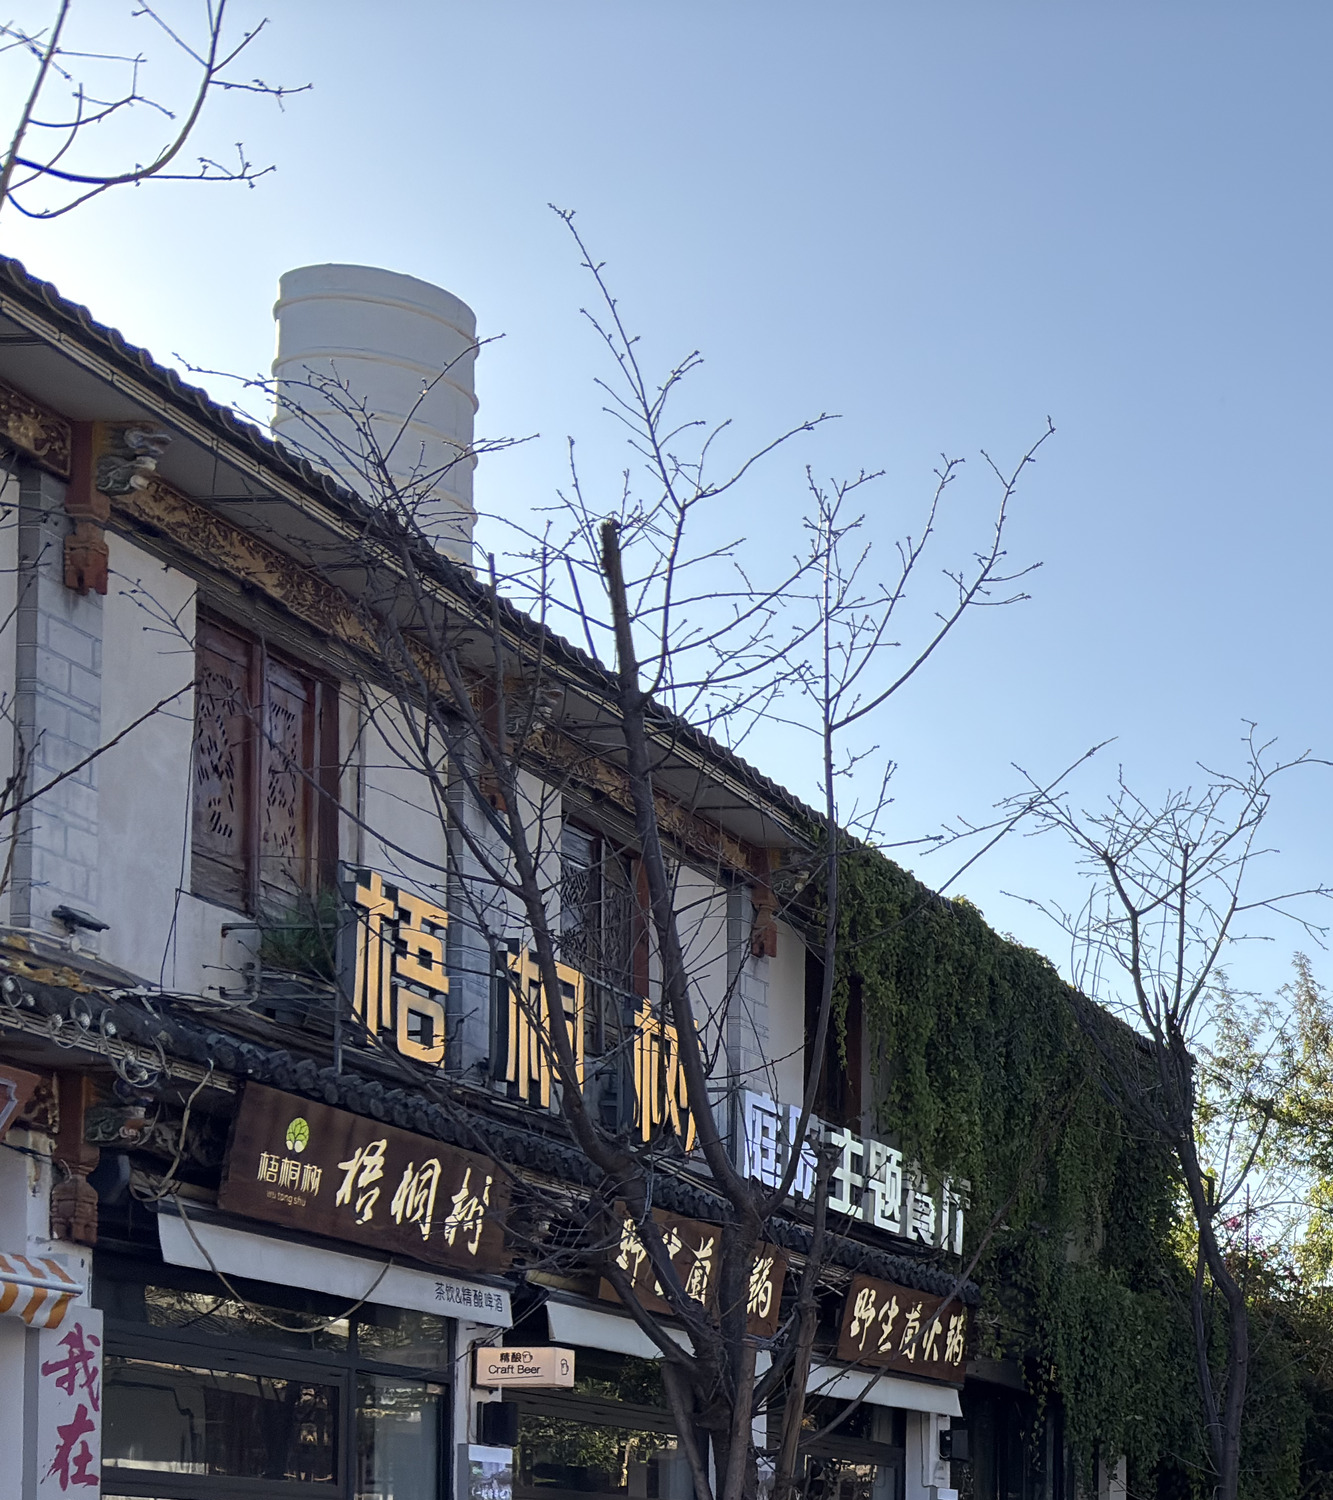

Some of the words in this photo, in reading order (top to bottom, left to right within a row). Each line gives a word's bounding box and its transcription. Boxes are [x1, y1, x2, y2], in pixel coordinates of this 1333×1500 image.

[257, 1151, 323, 1197] 梧桐树
[434, 1282, 503, 1313] 茶饮&精酿啤酒
[500, 1352, 522, 1363] 精酿
[488, 1365, 515, 1375] Craft
[517, 1365, 542, 1374] Beer
